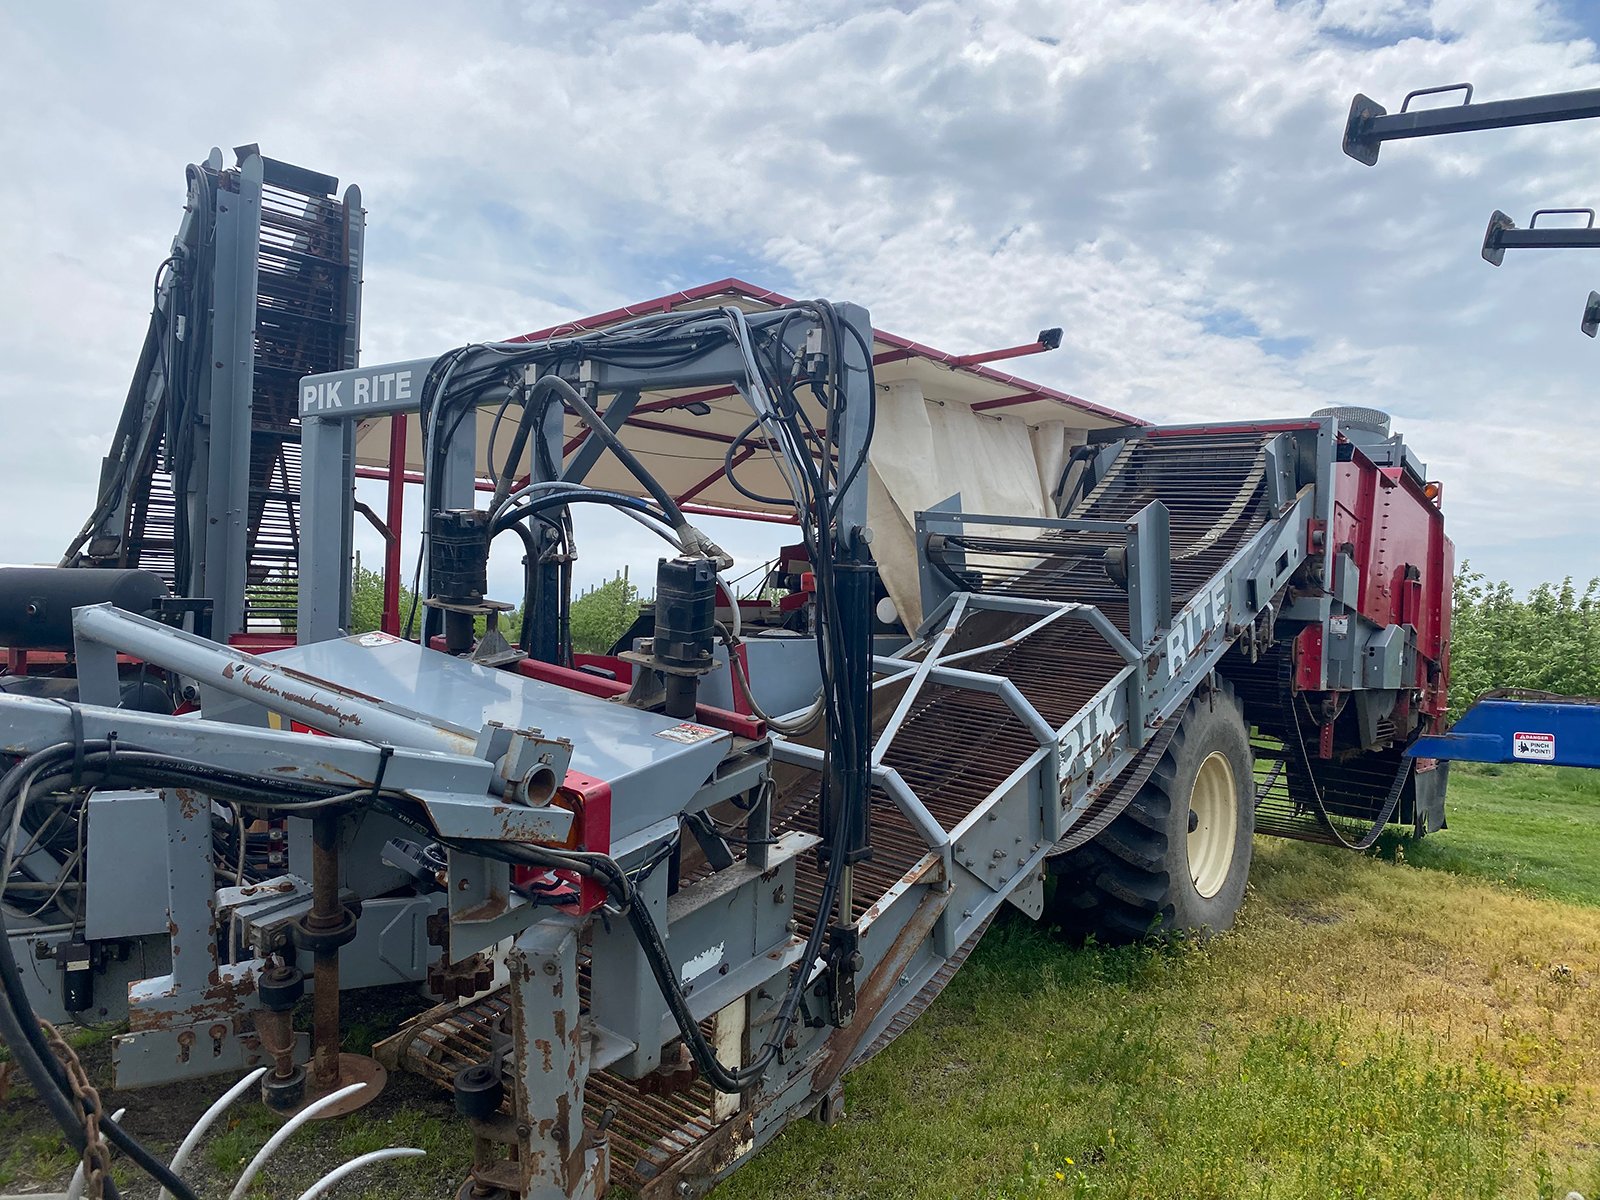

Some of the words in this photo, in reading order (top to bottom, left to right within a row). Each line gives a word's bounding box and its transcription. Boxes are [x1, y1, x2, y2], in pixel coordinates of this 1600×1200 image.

[303, 381, 342, 411] PIK
[354, 371, 411, 405] RITE
[1166, 576, 1226, 681] RITE
